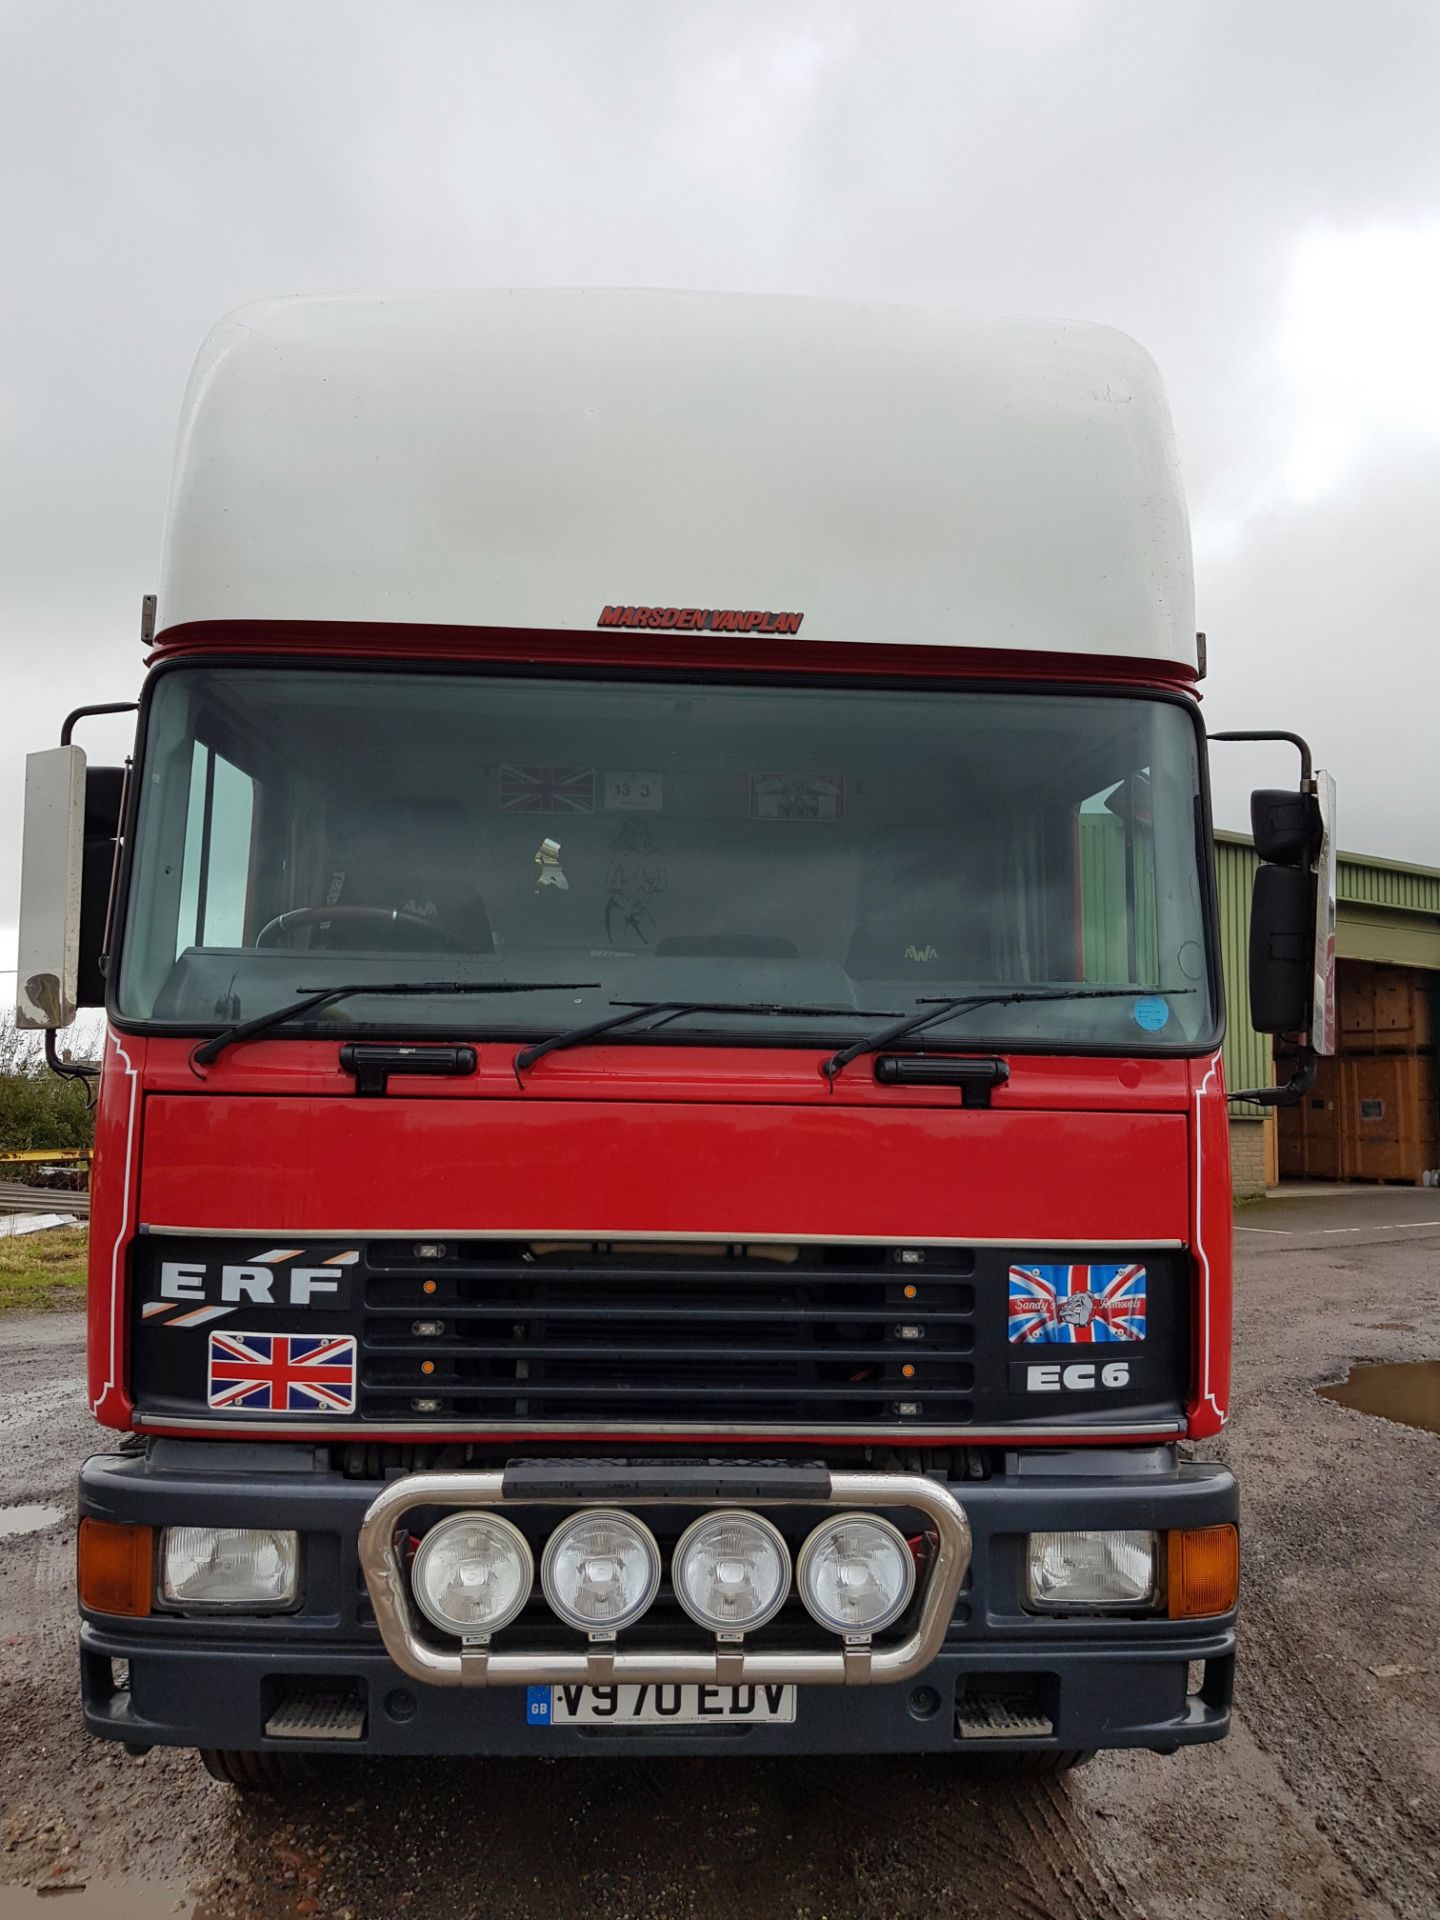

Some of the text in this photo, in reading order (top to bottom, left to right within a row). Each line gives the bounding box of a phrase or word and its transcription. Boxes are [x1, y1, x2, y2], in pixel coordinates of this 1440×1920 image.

[598, 606, 804, 634] MARSDEN VANPLAN
[160, 1261, 342, 1305] ERF
[1014, 1297, 1141, 1312] Sandy's Removals
[1026, 1362, 1130, 1391] EC6
[531, 1703, 548, 1715] GB
[562, 1684, 785, 1716] V970 EDV
